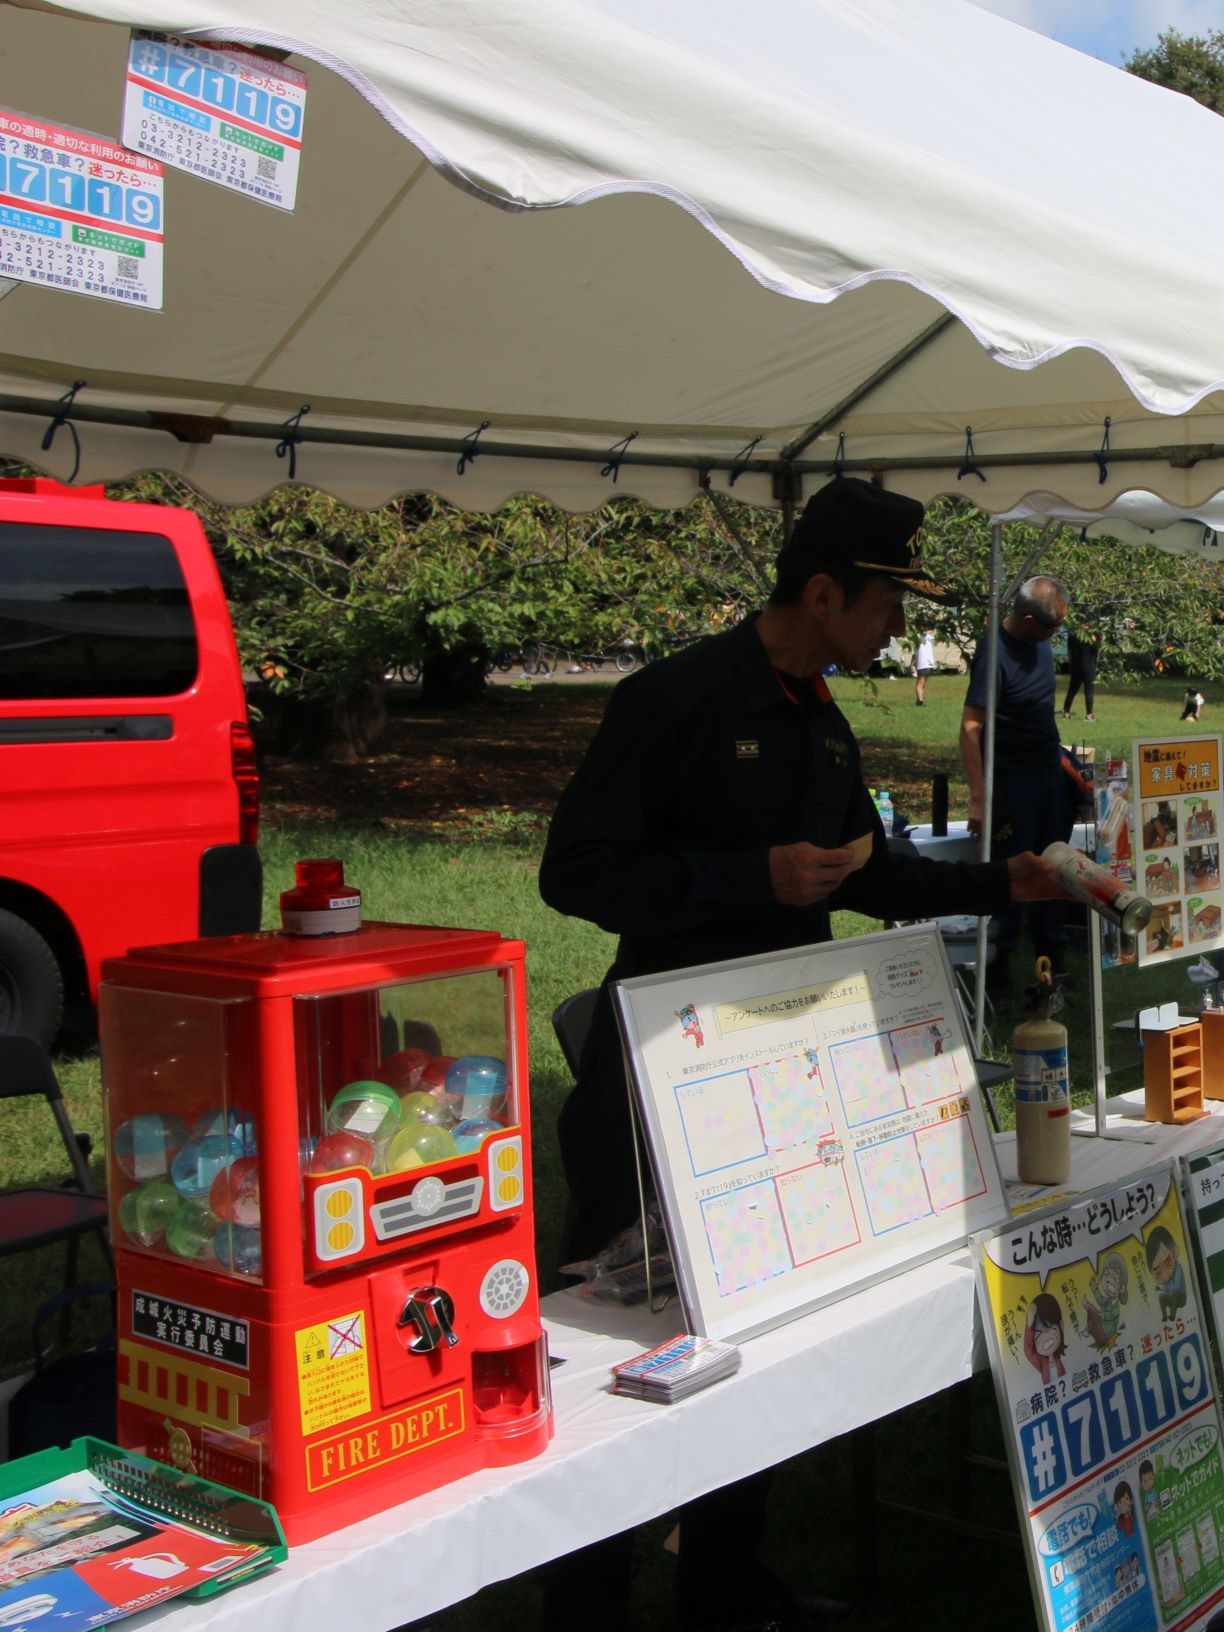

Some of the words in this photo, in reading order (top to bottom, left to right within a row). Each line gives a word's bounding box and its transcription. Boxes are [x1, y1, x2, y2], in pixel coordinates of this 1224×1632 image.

[138, 140, 175, 162] 東京消防庁
[141, 119, 246, 168] 03-3212-2323
[149, 112, 239, 154] こちらからもつながります
[140, 131, 245, 179] 042-521-2323
[0, 251, 105, 283] 2-521-2323
[29, 269, 81, 289] 東京都医師会
[135, 1297, 246, 1345] 成城火災予防運動
[156, 1321, 224, 1357] 実行委員会
[1141, 1316, 1196, 1355] 迷ったら…
[302, 1349, 326, 1365] 注意
[1087, 1343, 1135, 1383] 救急車？
[1030, 1380, 1067, 1415] 病院？
[1031, 1342, 1202, 1493] #7119
[321, 1430, 380, 1478] FIRE
[389, 1403, 454, 1450] DEPT.
[1046, 1507, 1092, 1552] 電話でも！
